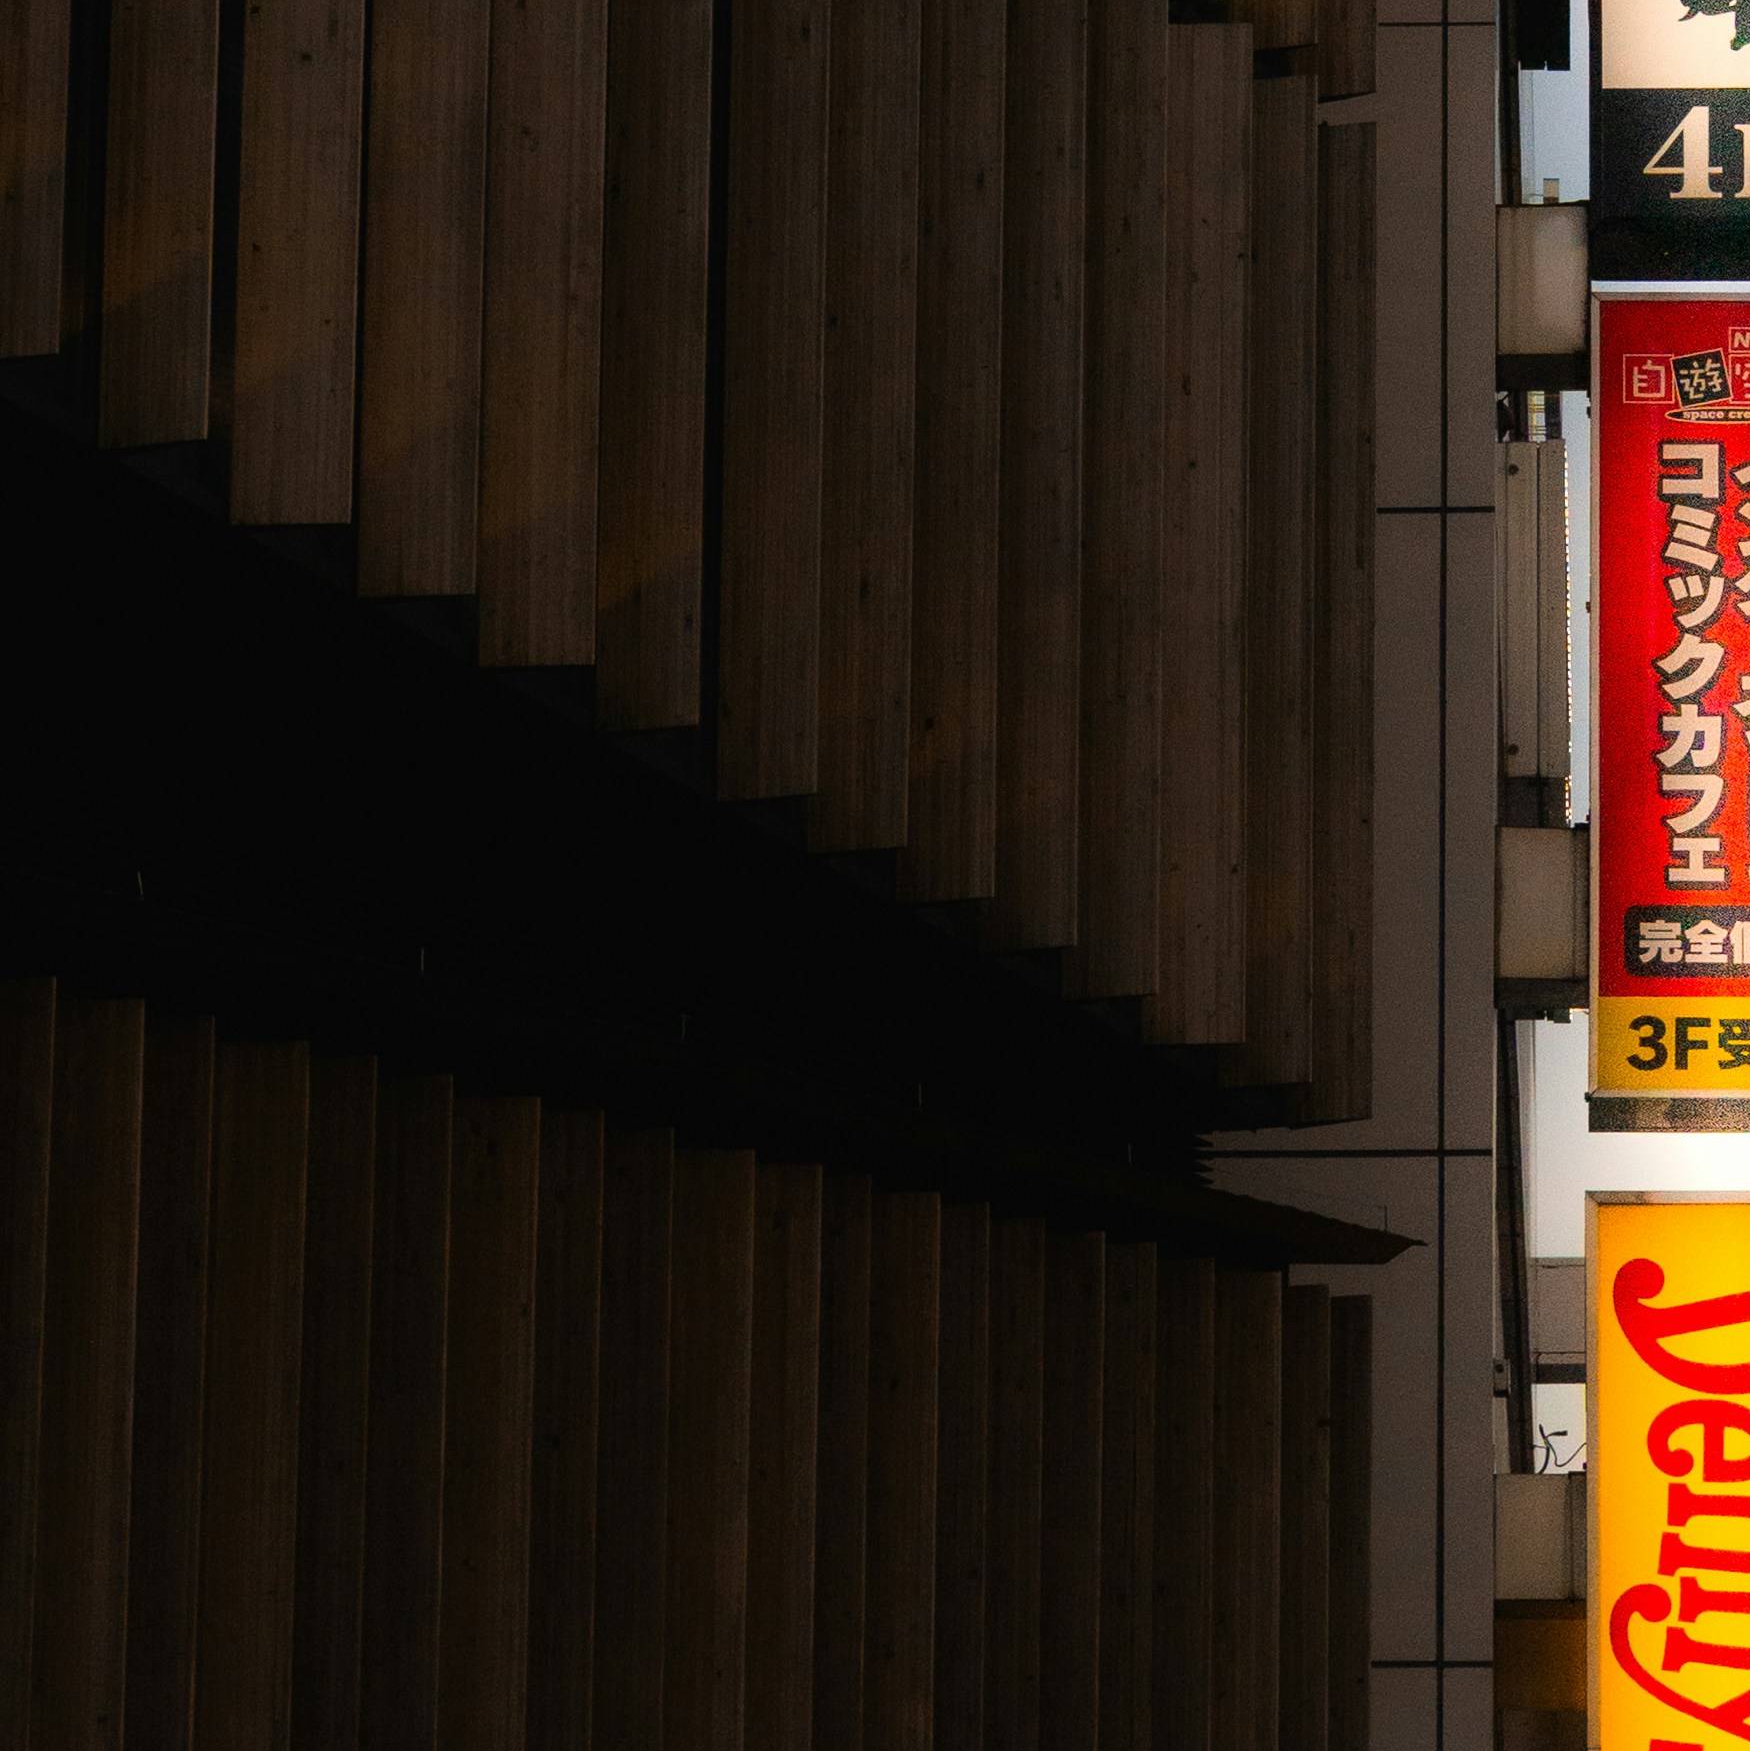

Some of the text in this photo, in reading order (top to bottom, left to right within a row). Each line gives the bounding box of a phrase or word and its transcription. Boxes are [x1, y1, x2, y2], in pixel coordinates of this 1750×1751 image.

[1656, 443, 1726, 883] コミックカフェ
